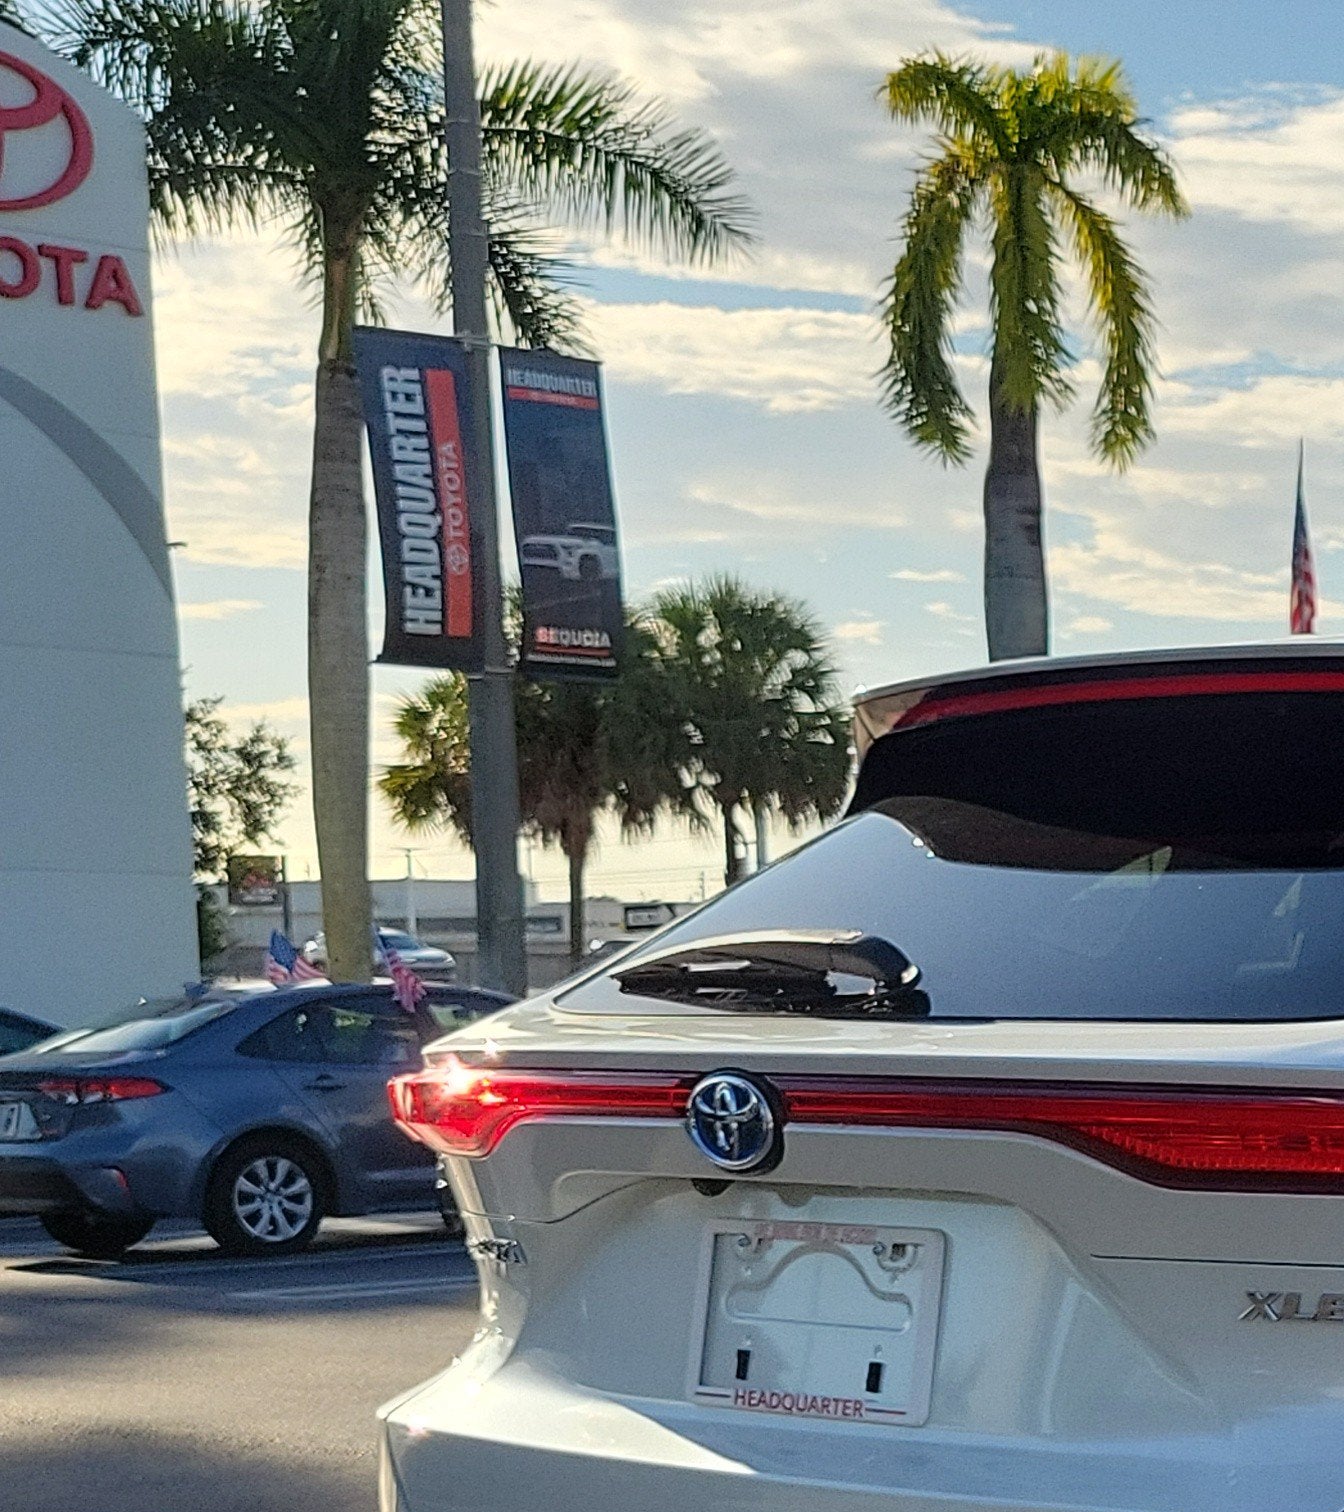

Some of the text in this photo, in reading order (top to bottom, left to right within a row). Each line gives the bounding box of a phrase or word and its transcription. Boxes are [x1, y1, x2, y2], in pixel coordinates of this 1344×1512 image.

[381, 365, 443, 635] HEADQUARTER
[440, 441, 470, 539] TOYOTA
[733, 1388, 864, 1418] HEADQUARTER
